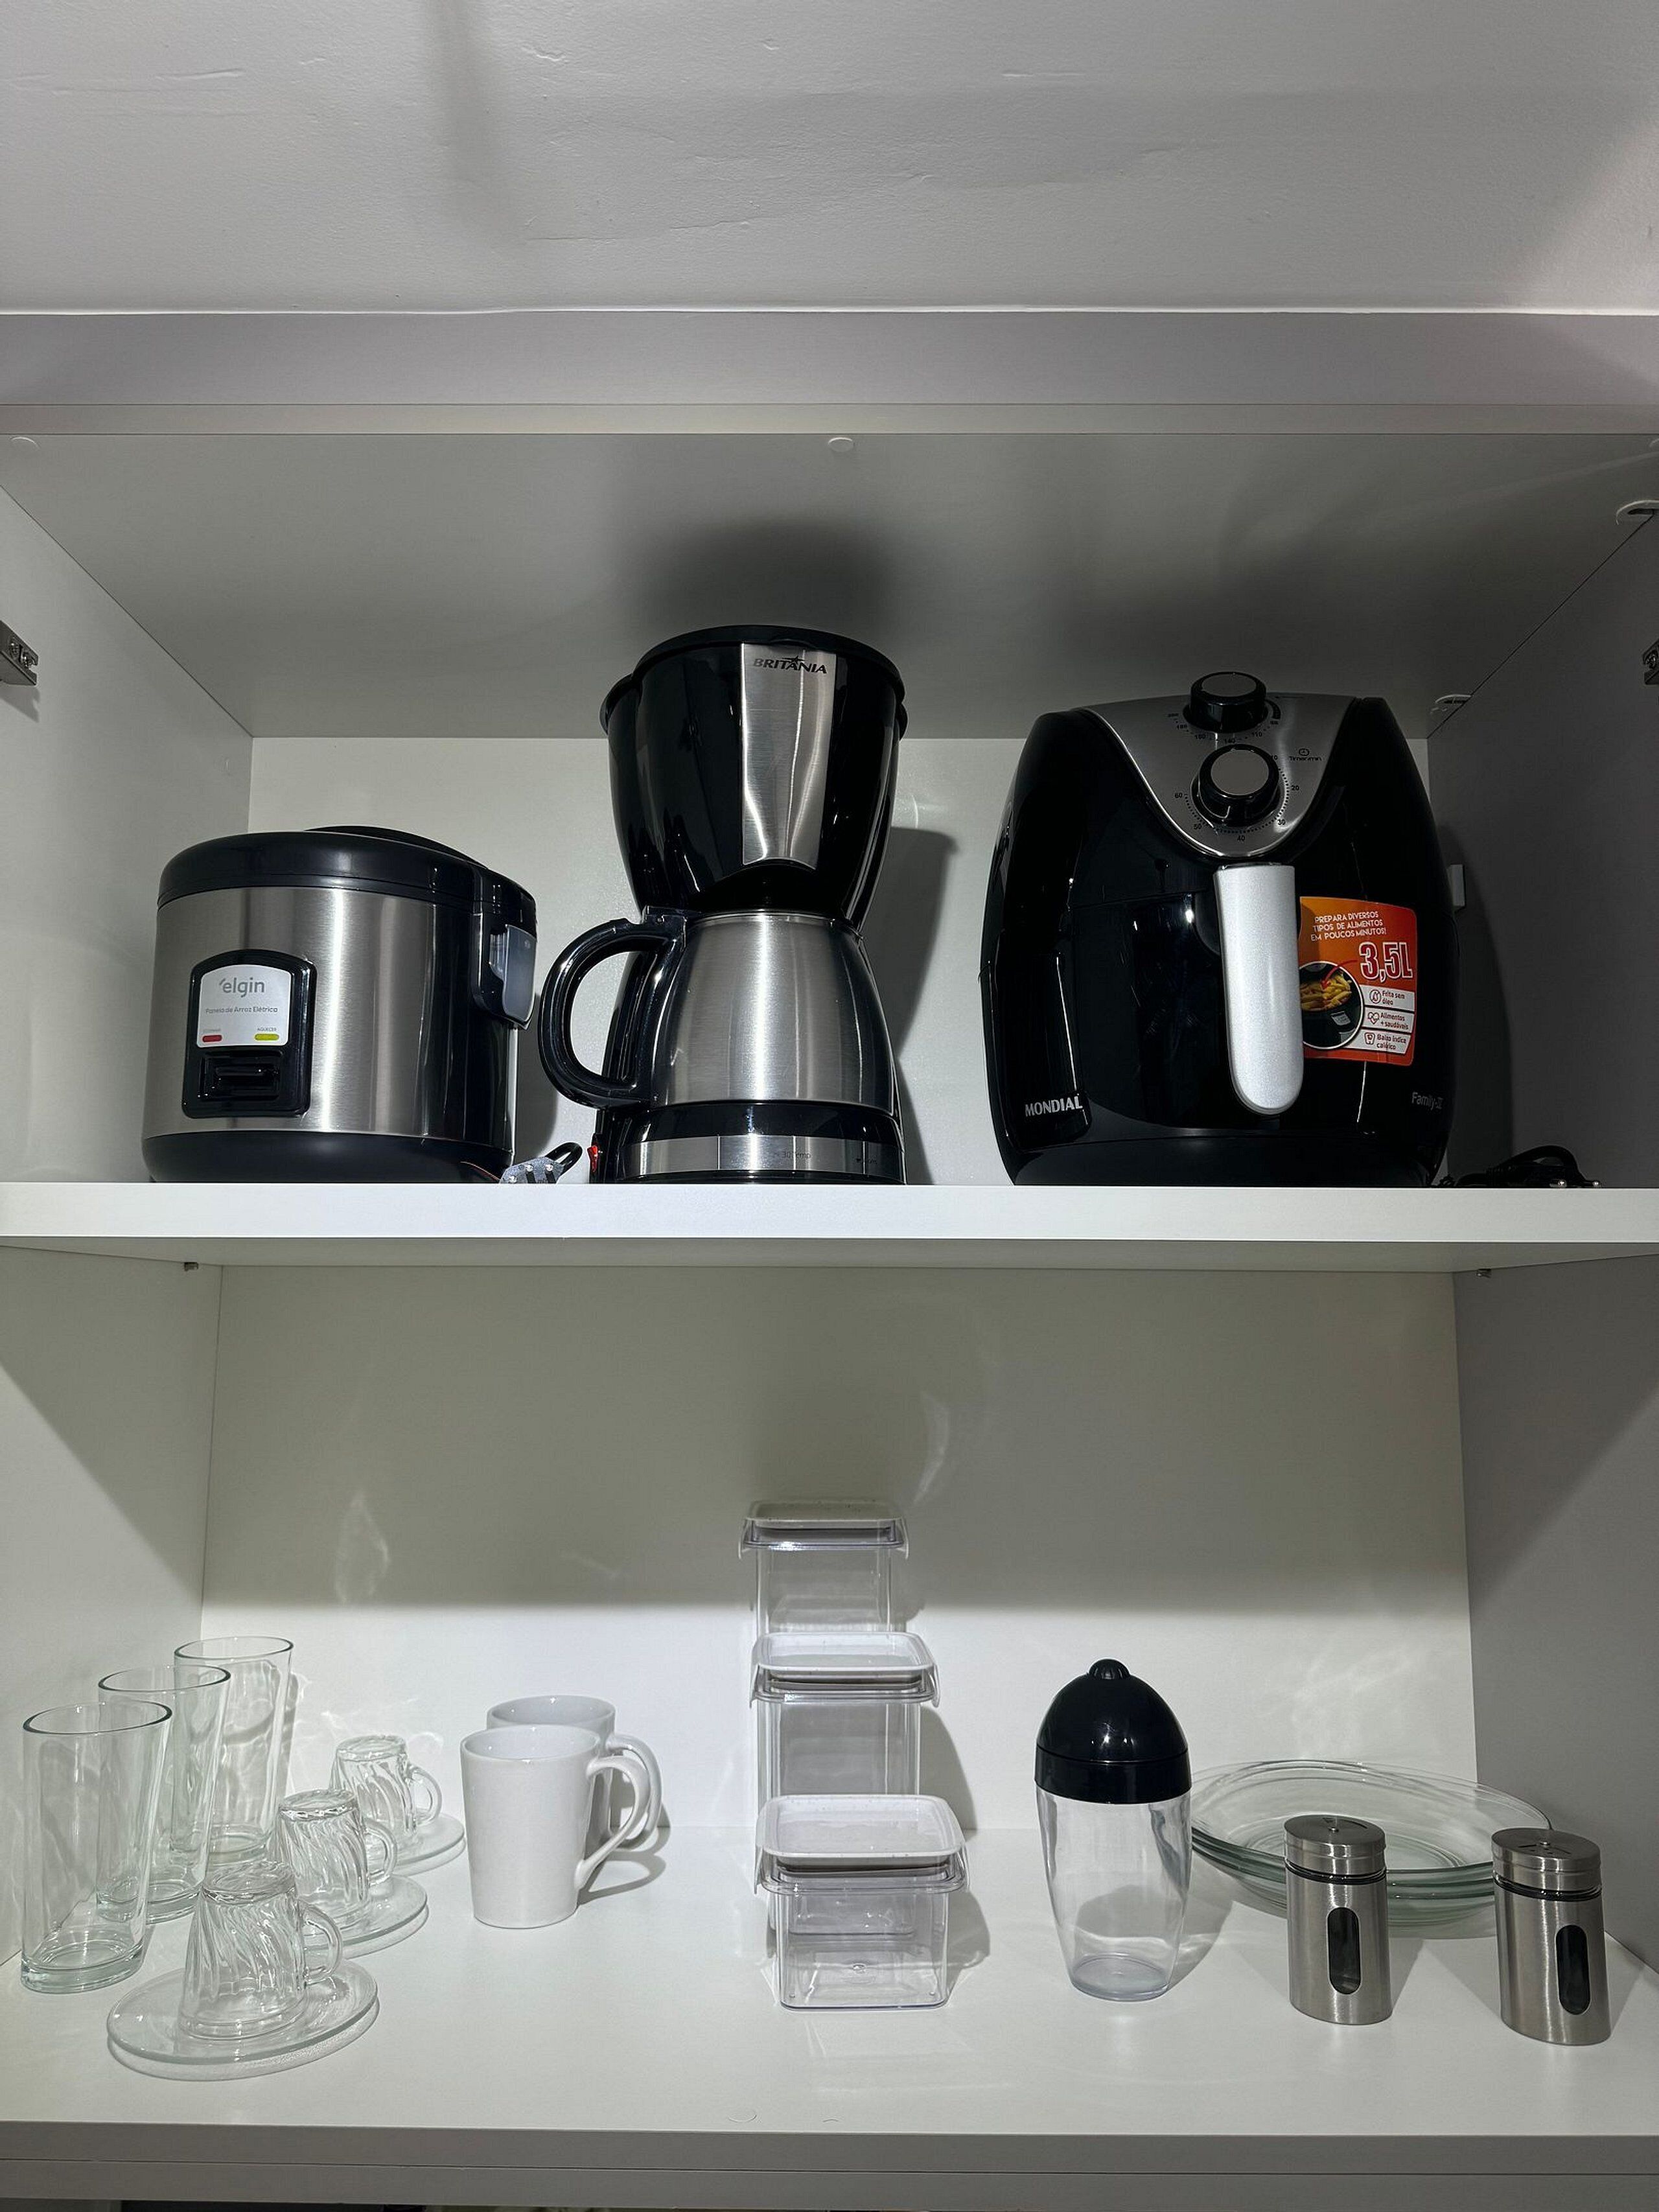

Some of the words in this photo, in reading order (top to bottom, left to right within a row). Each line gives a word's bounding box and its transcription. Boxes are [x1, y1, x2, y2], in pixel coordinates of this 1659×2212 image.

[1314, 914, 1347, 924] PREPARA
[1348, 911, 1378, 920] DIVERSOS
[1313, 924, 1334, 932] TIPOS
[1347, 919, 1384, 929] ALIMENTOS
[1324, 930, 1355, 940] POUCOS
[1359, 942, 1413, 983] 3,5L
[1025, 1095, 1083, 1117] MONDIAL
